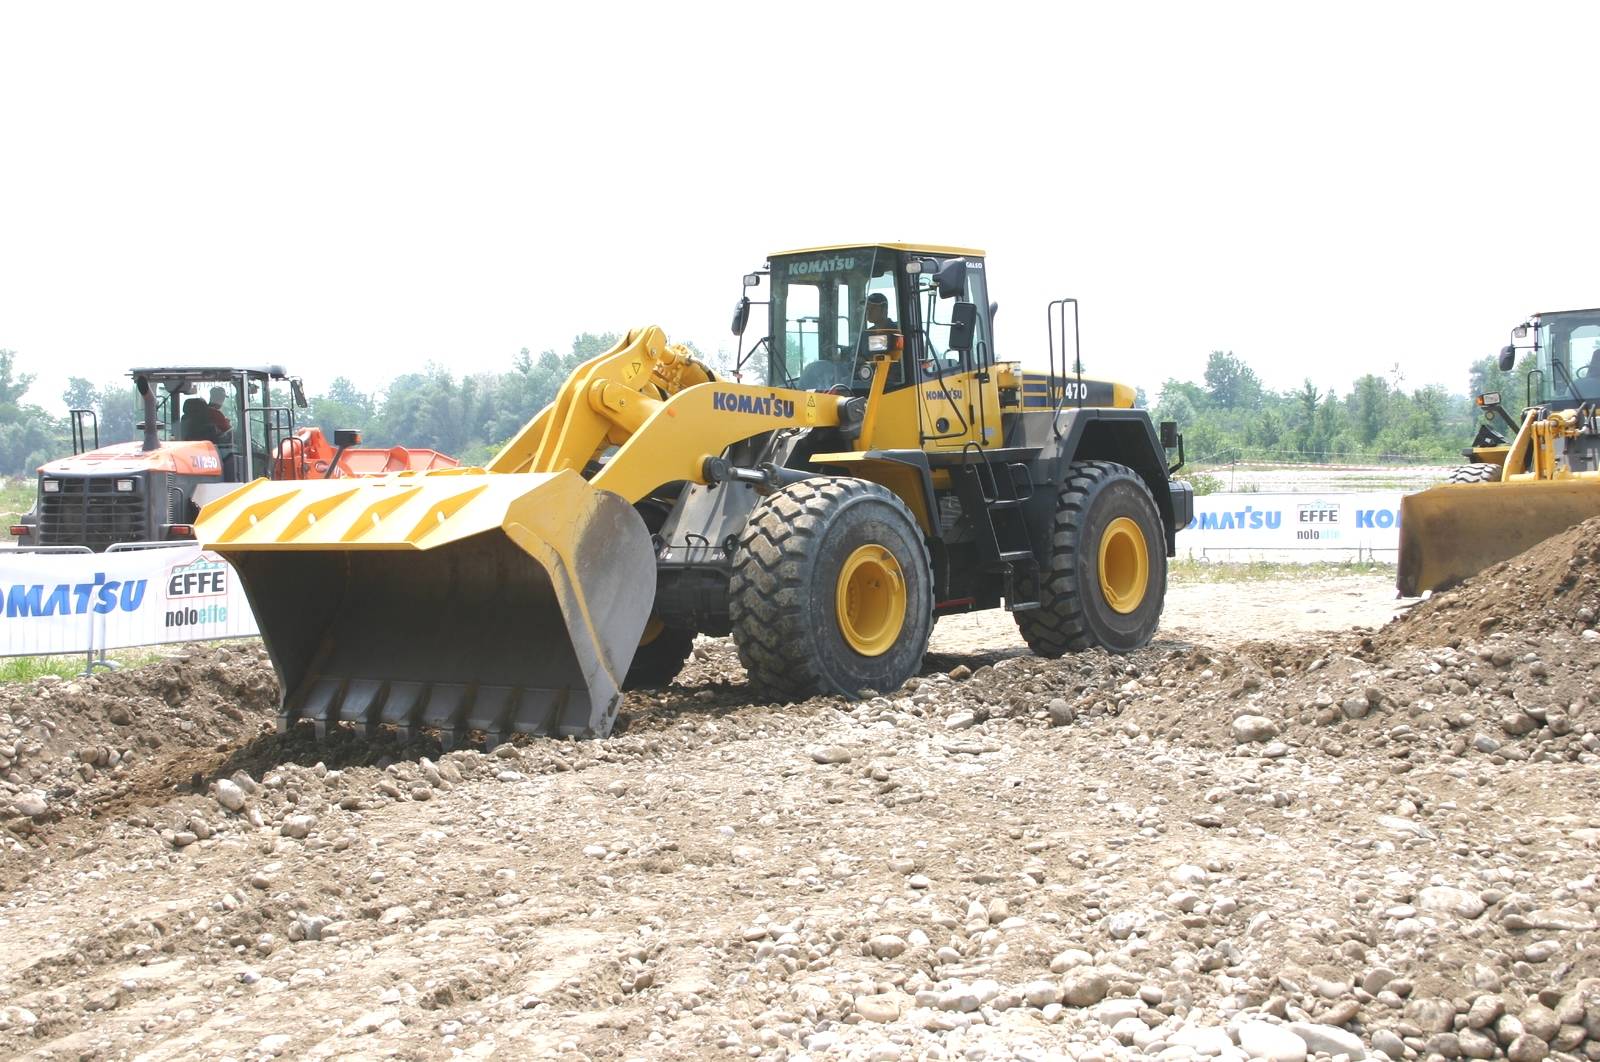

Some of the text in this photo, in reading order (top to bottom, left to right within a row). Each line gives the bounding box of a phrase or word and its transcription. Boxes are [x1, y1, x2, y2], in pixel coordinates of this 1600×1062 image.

[788, 256, 855, 275] KOMATSU
[713, 391, 794, 418] KOMATSU
[1299, 510, 1338, 522] EFFE
[169, 571, 225, 595] EFFE
[0, 572, 148, 618] MATSU
[165, 604, 227, 627] noloeffe
